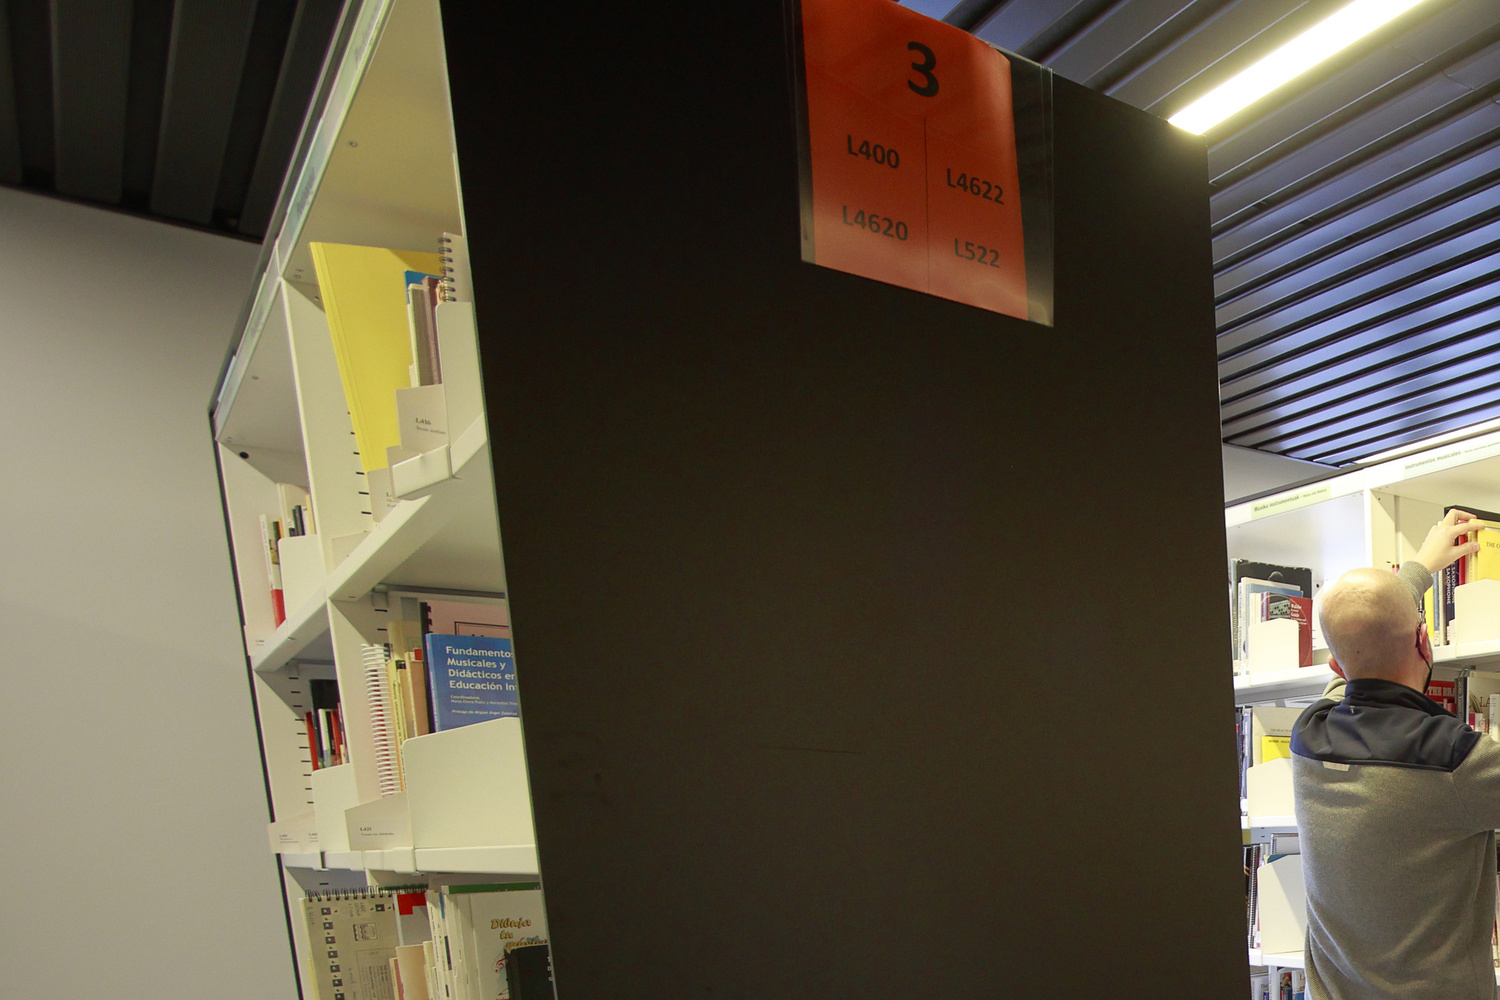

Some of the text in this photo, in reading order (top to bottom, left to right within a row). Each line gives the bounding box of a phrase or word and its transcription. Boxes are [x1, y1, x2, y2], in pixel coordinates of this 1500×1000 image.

[908, 41, 939, 98] 3
[847, 134, 900, 169] L400
[946, 168, 1004, 205] L4622
[842, 205, 908, 242] L4620
[953, 238, 1000, 268] L522
[447, 658, 506, 670] Musicales y
[448, 668, 502, 680] Didácticos
[449, 680, 517, 691] Educación In
[1428, 686, 1442, 696] THE
[491, 917, 531, 930] Dibuja
